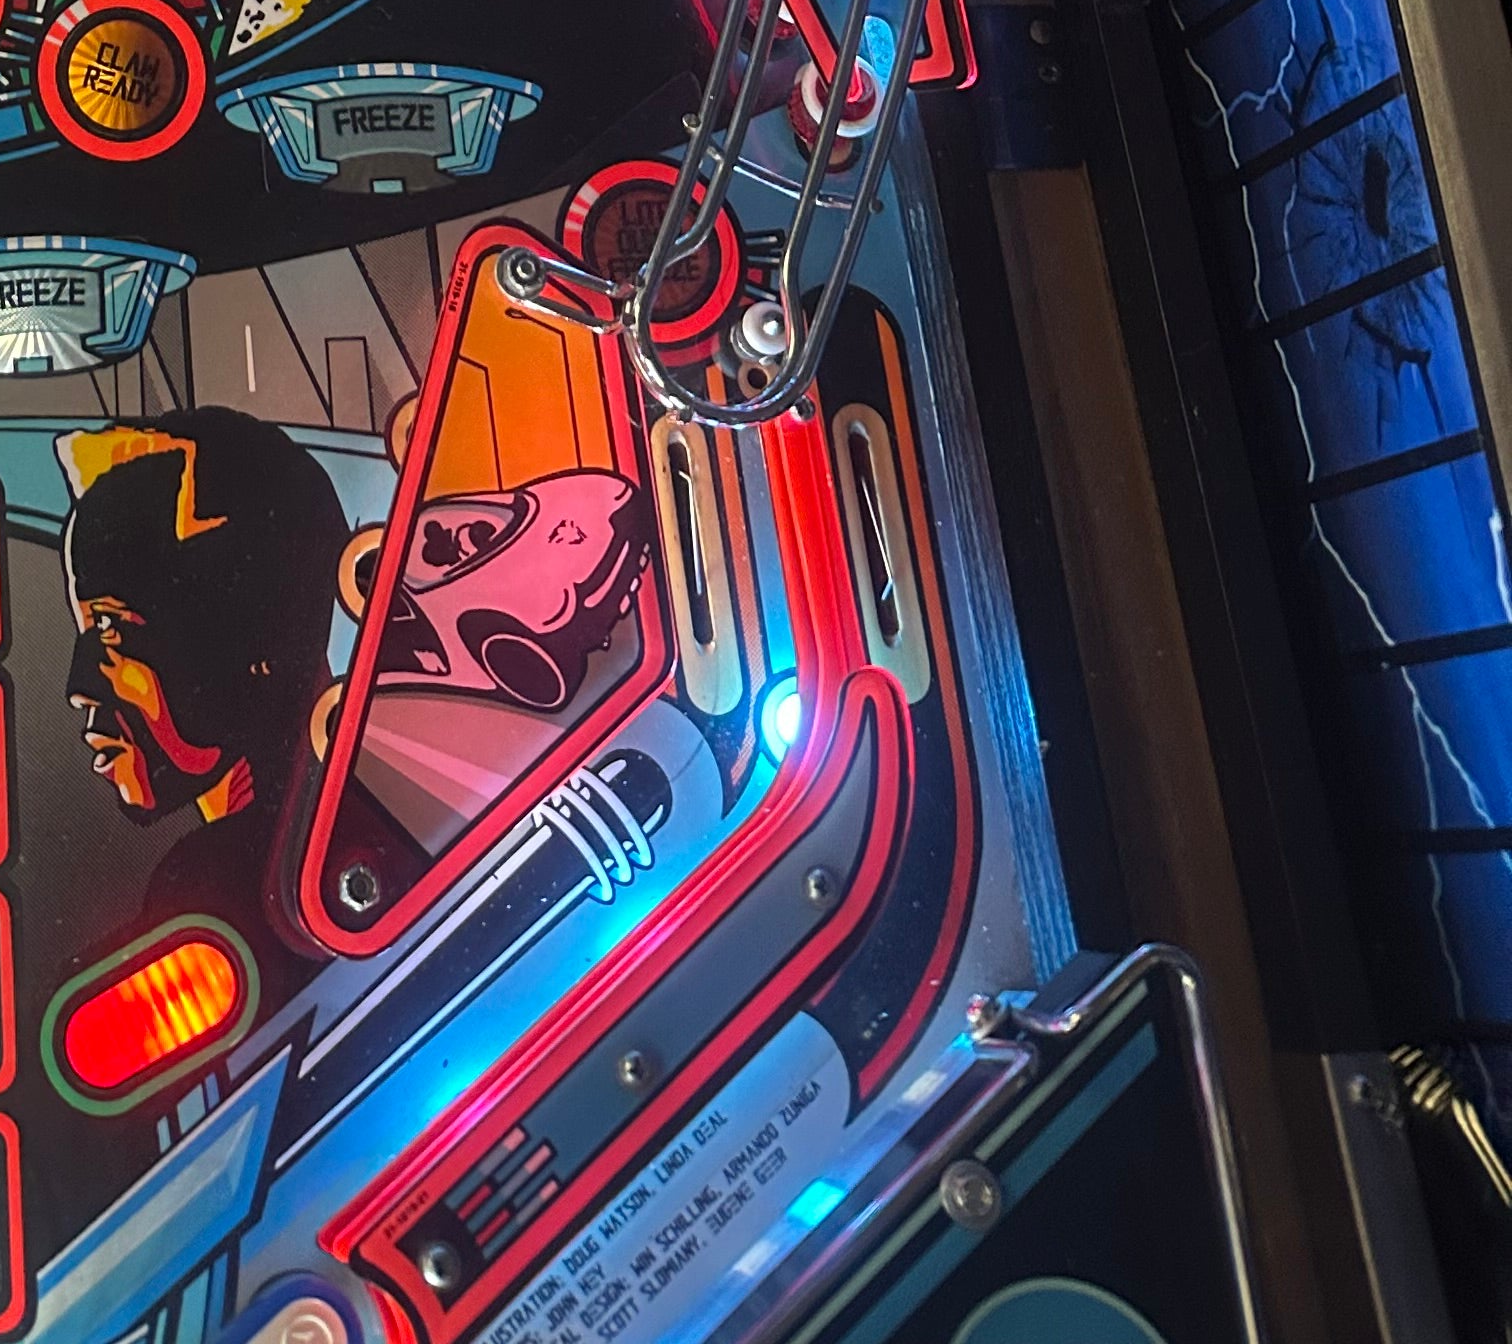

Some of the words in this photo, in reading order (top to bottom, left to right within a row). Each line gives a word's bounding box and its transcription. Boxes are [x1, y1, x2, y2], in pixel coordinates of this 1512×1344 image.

[96, 41, 161, 76] CLAW
[82, 66, 161, 106] READY
[333, 103, 436, 136] FREEZE
[561, 1235, 601, 1276] DOUG
[654, 1142, 694, 1184] LINDA
[691, 1110, 729, 1147] DEAL
[579, 1277, 632, 1329] DESIGN:
[629, 1246, 657, 1278] WIN
[722, 1122, 780, 1185] ARMANDO
[779, 1080, 822, 1127] ZUNIGA
[597, 1296, 640, 1342] SCOTT
[704, 1179, 755, 1236] EUGENE
[753, 1146, 788, 1185] GEER
[546, 1292, 580, 1332] JOHN
